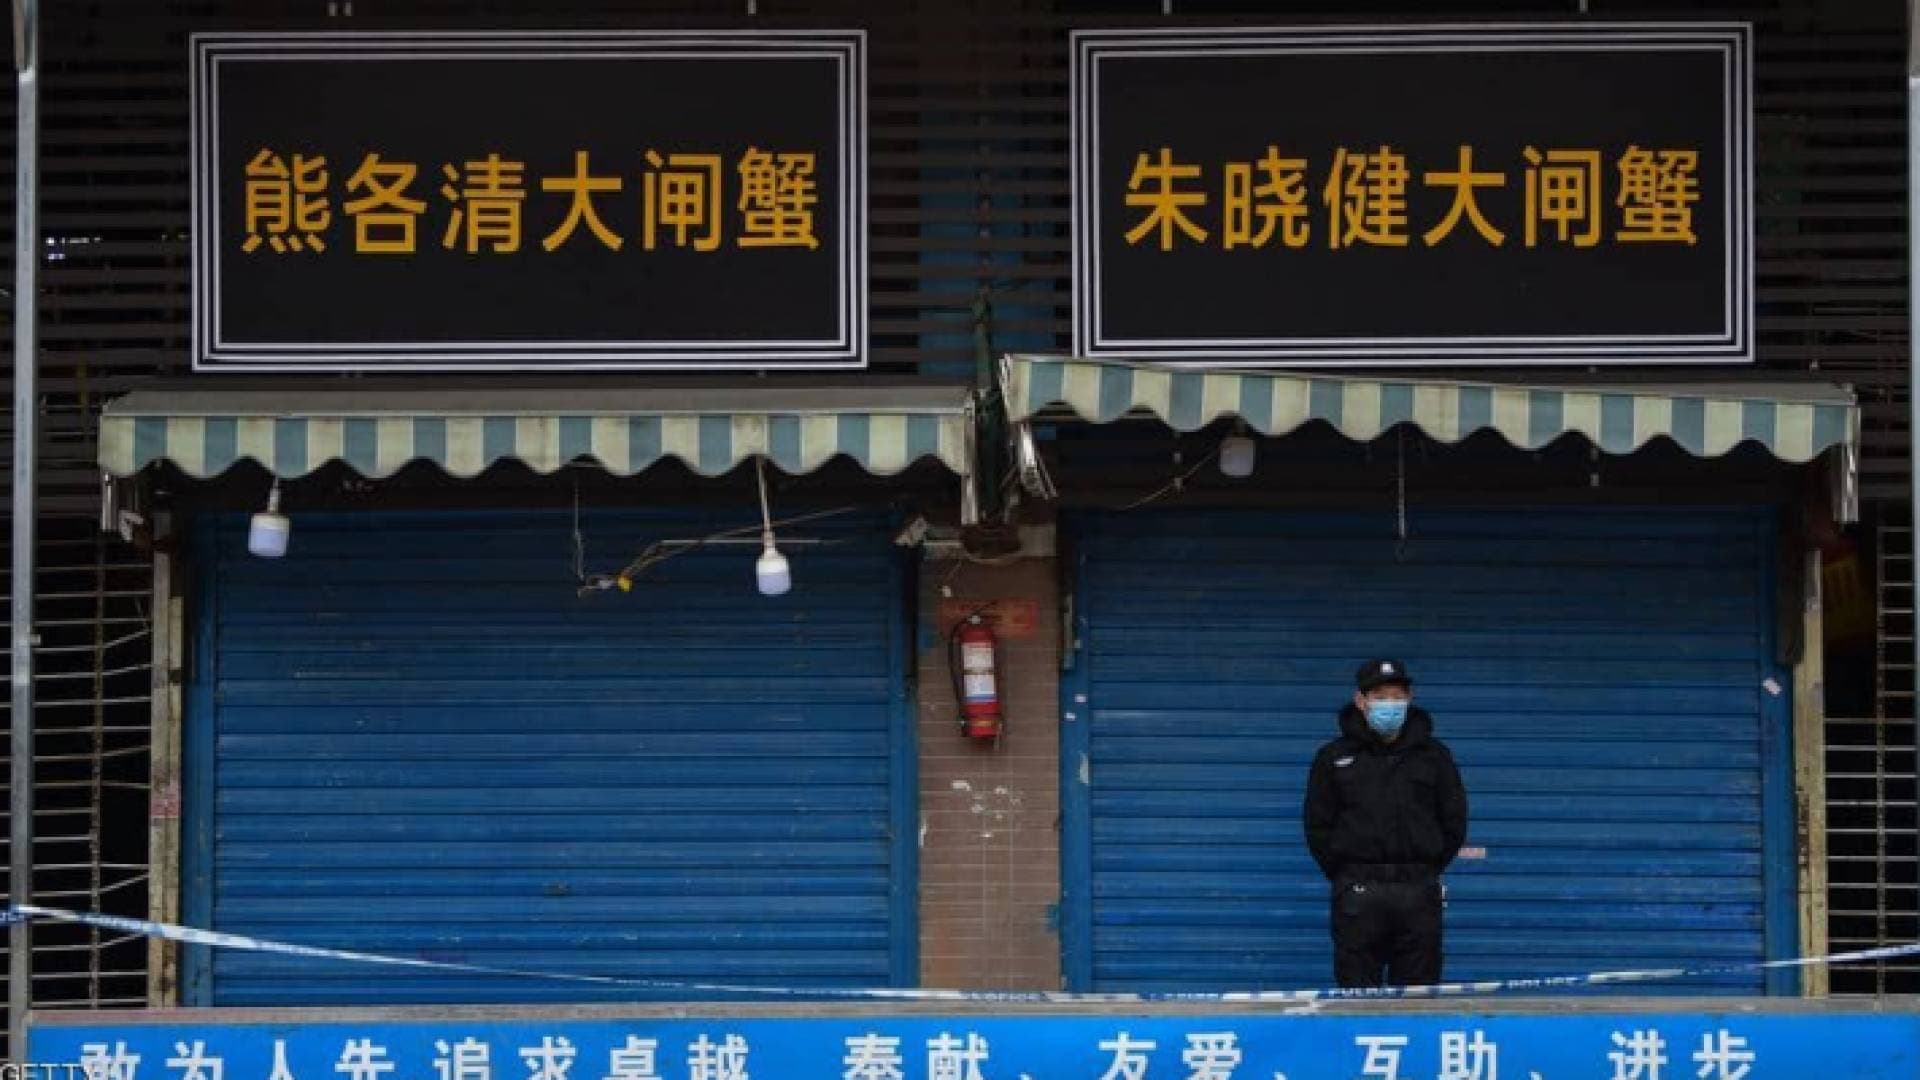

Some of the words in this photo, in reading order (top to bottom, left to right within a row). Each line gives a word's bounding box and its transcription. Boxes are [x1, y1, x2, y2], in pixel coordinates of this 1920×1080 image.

[242, 146, 819, 255] 熊各清大闸蟹
[1124, 144, 1700, 251] 朱晓健大闸蟹
